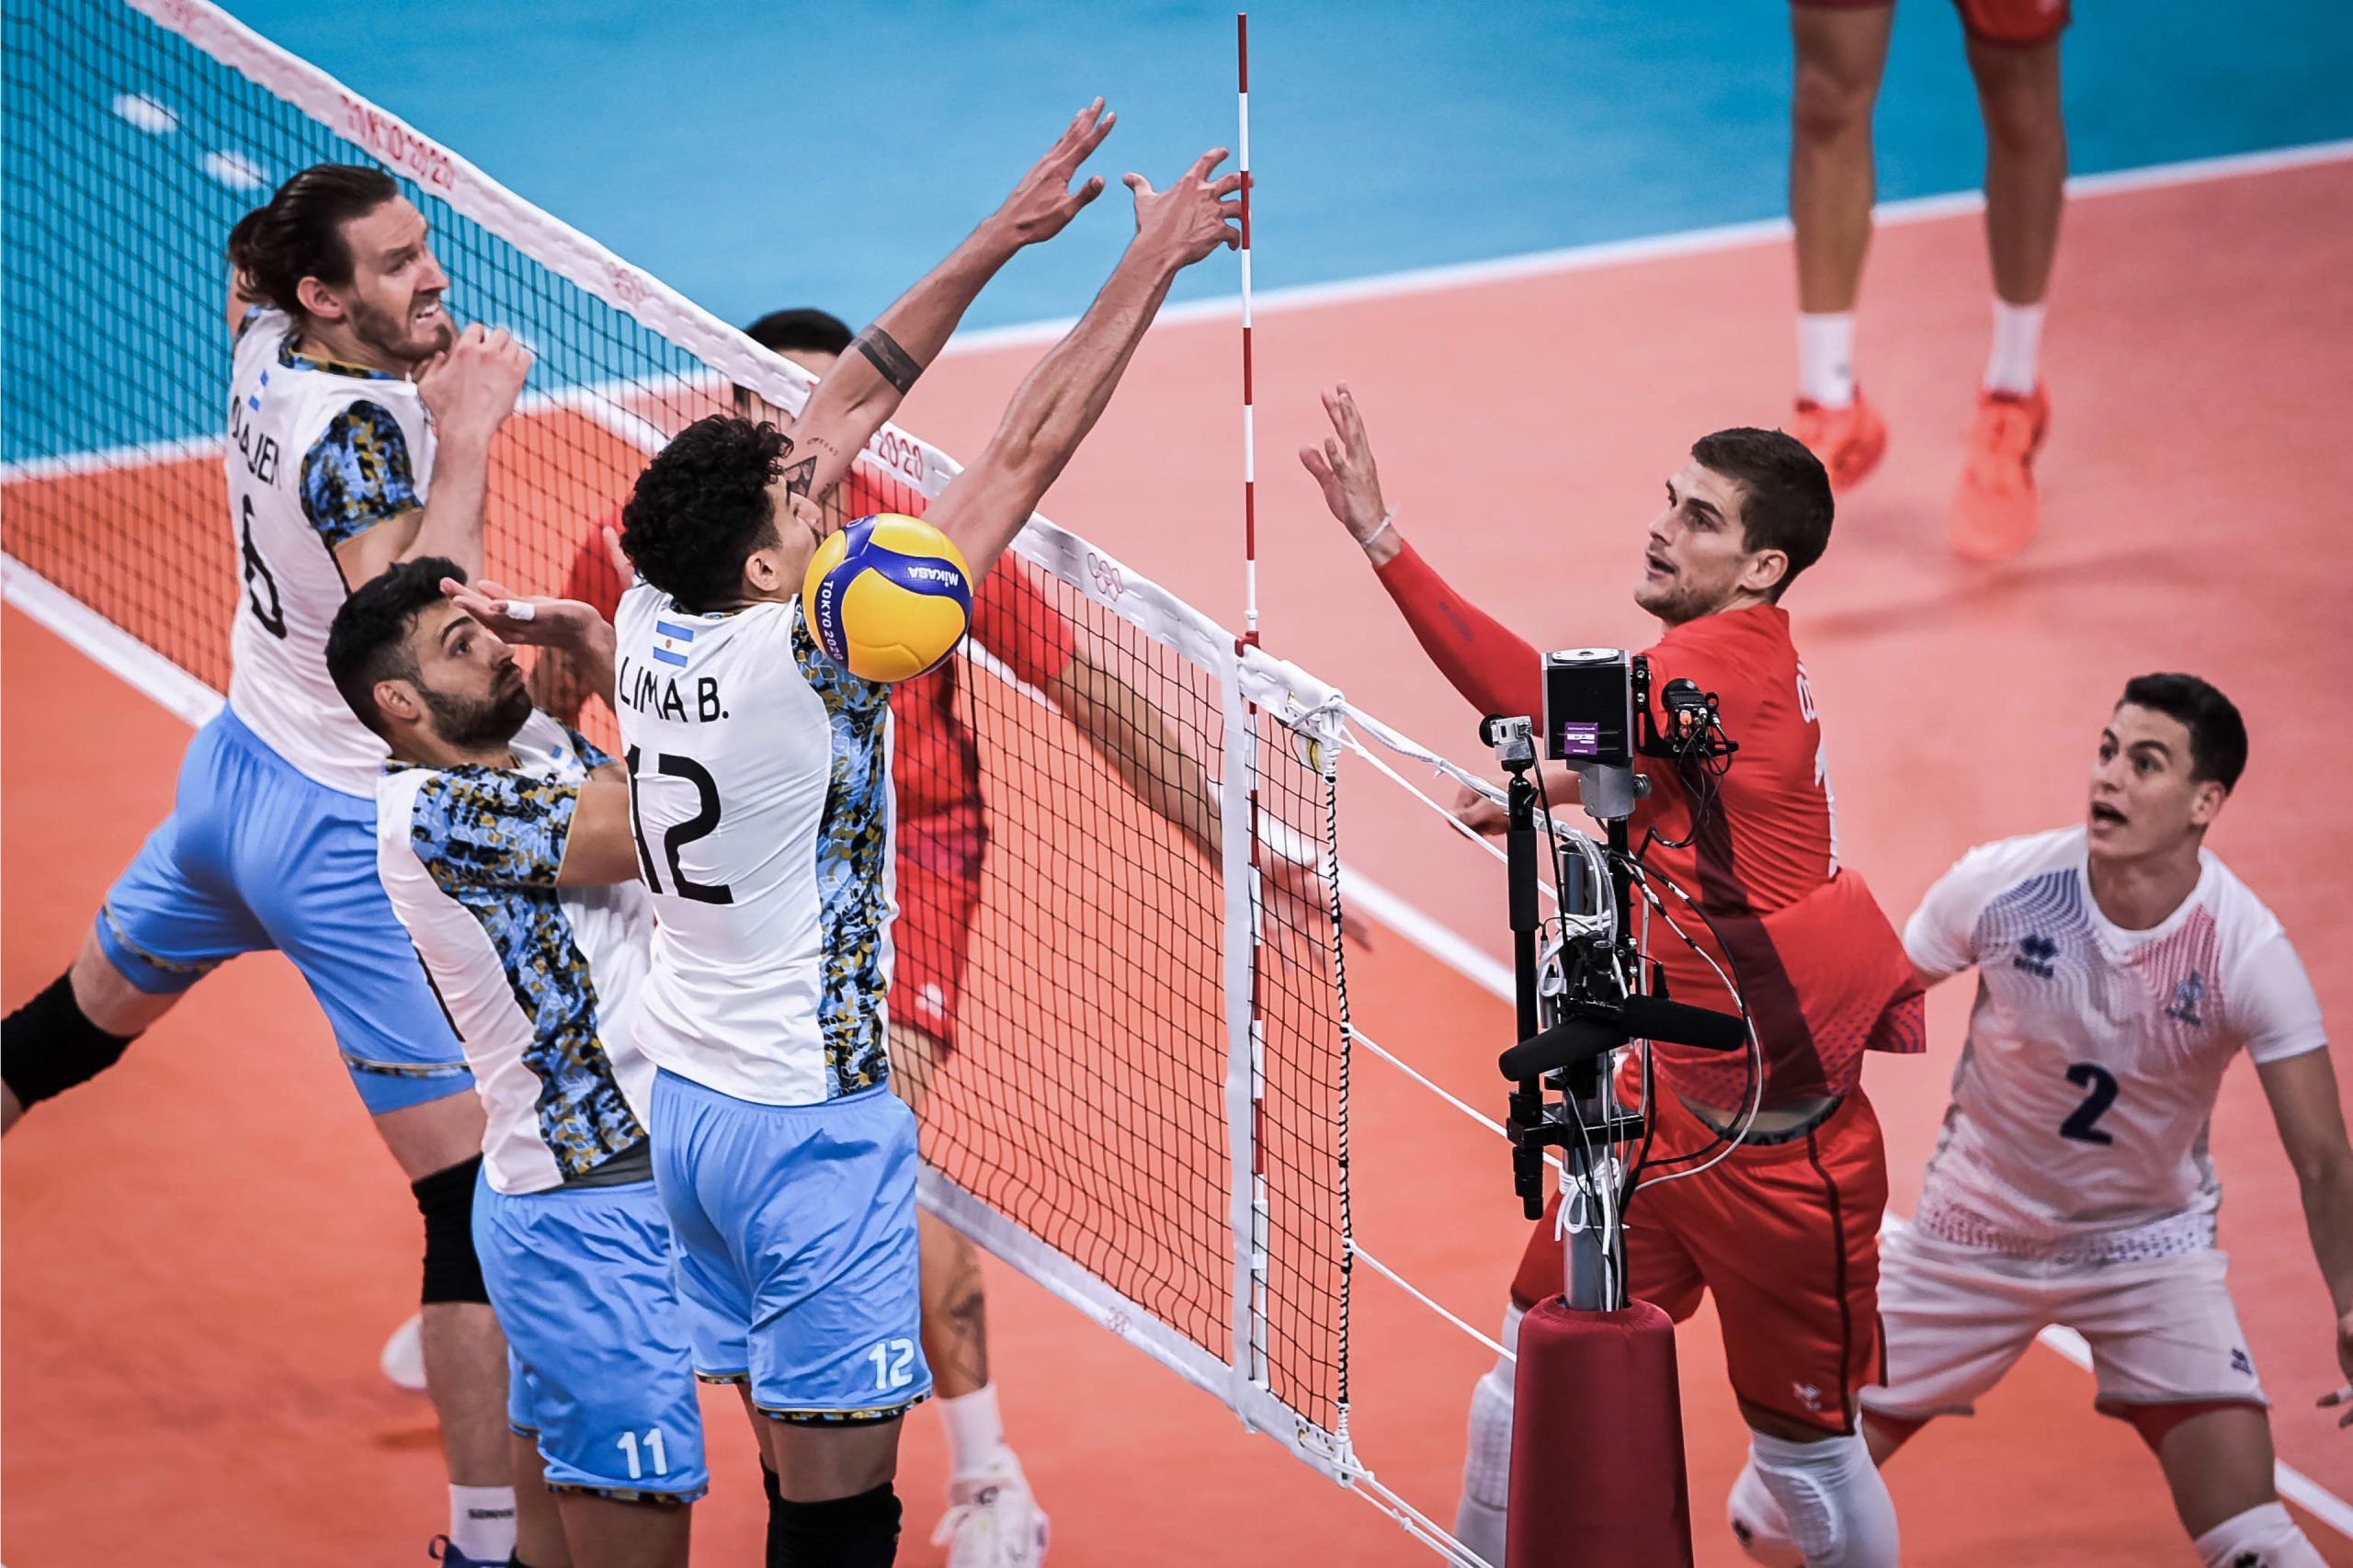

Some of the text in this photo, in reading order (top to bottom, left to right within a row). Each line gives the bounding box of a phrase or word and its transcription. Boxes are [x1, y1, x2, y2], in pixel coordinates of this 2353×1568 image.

[242, 493, 288, 640] 6
[821, 580, 844, 661] TOKYO 2020
[620, 655, 729, 723] LIMA B.
[624, 743, 734, 905] 12
[2059, 1061, 2120, 1147] 2
[868, 1337, 915, 1391] 12
[617, 1426, 668, 1480] 11
